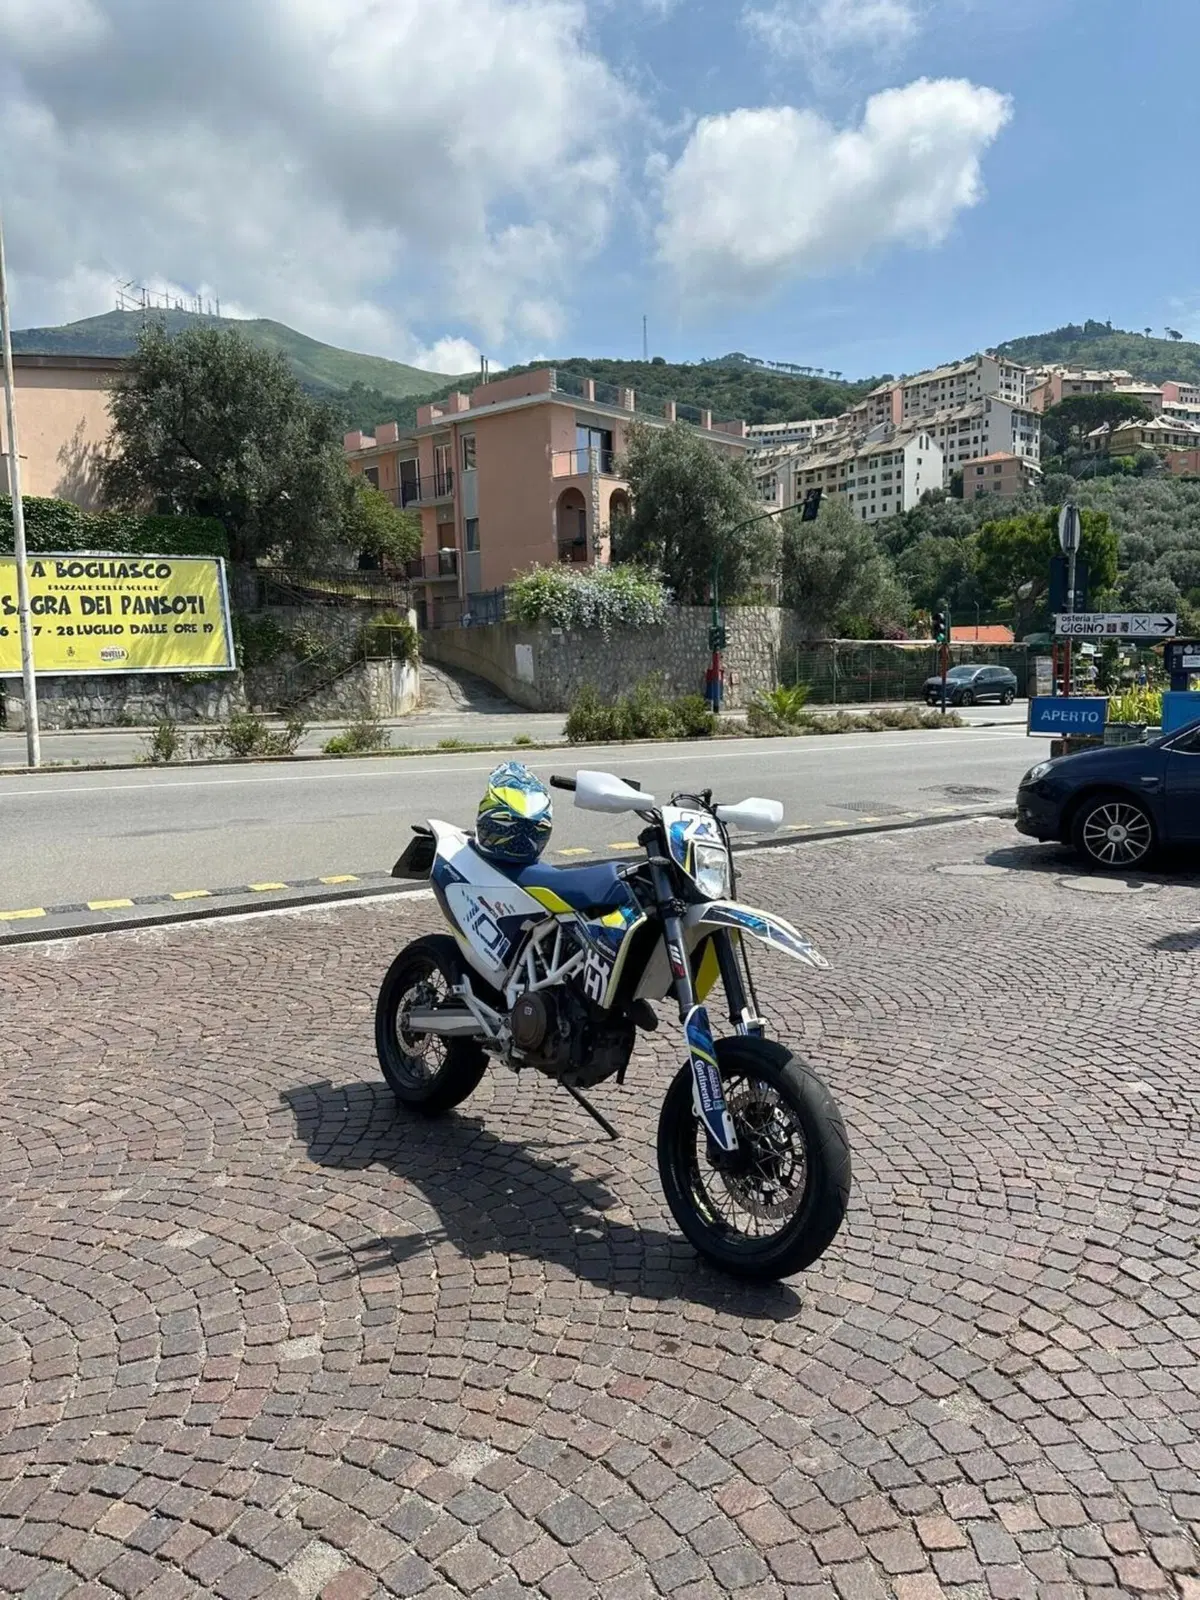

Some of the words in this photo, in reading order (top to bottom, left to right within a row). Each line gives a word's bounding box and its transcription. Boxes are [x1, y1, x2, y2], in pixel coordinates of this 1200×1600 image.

[31, 561, 46, 578] A
[56, 561, 172, 579] BOGLIASCO
[1, 594, 72, 616] SGRA
[80, 595, 112, 616] DEI
[121, 594, 205, 616] PANSOTI
[1061, 614, 1091, 623] osteria
[56, 625, 75, 636] 28
[77, 623, 124, 636] LUGLIO
[130, 623, 168, 635] DALLE
[173, 623, 198, 634] ORE
[203, 622, 214, 633] 19
[1040, 709, 1100, 723] APERTO
[694, 1059, 714, 1112] Continental
